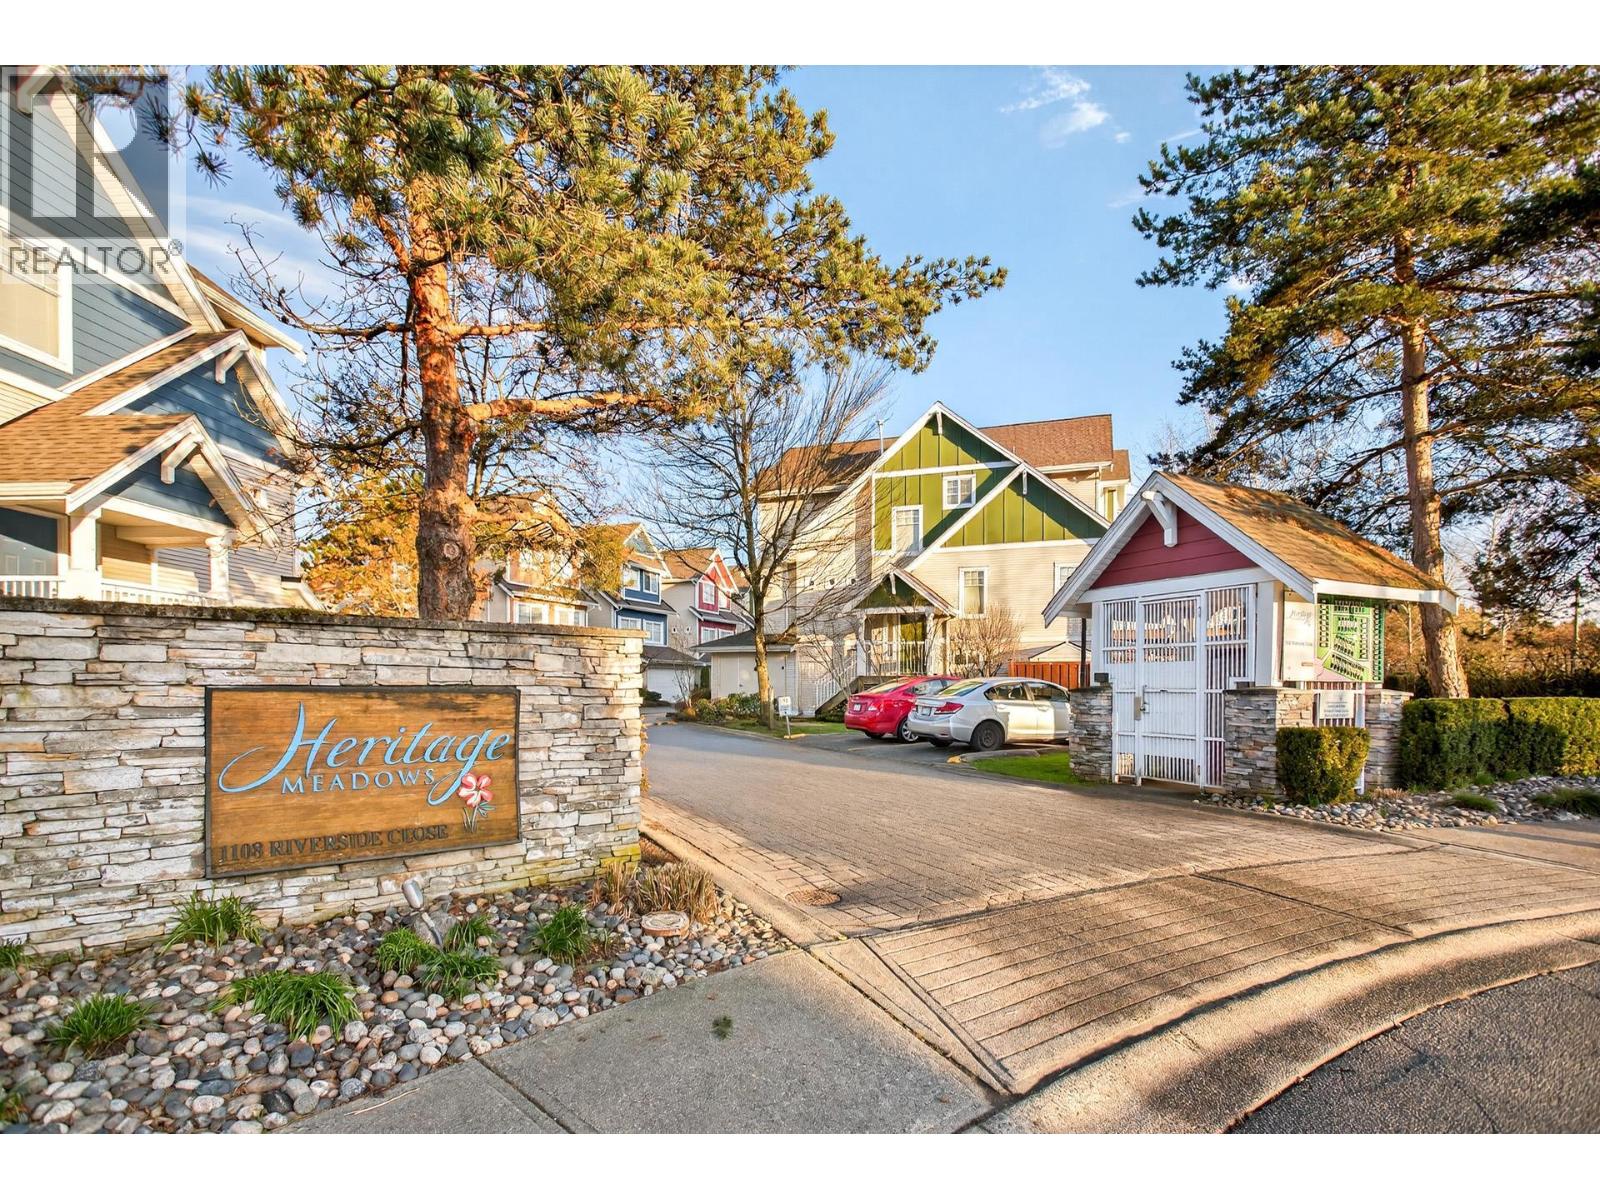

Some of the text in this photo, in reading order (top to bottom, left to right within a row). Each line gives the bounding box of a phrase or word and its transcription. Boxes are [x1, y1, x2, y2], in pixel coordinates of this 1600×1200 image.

[218, 702, 512, 806] Heritage
[281, 768, 435, 794] MEADOWS
[219, 824, 449, 863] 1108 RIVERSIDE CLOSE
